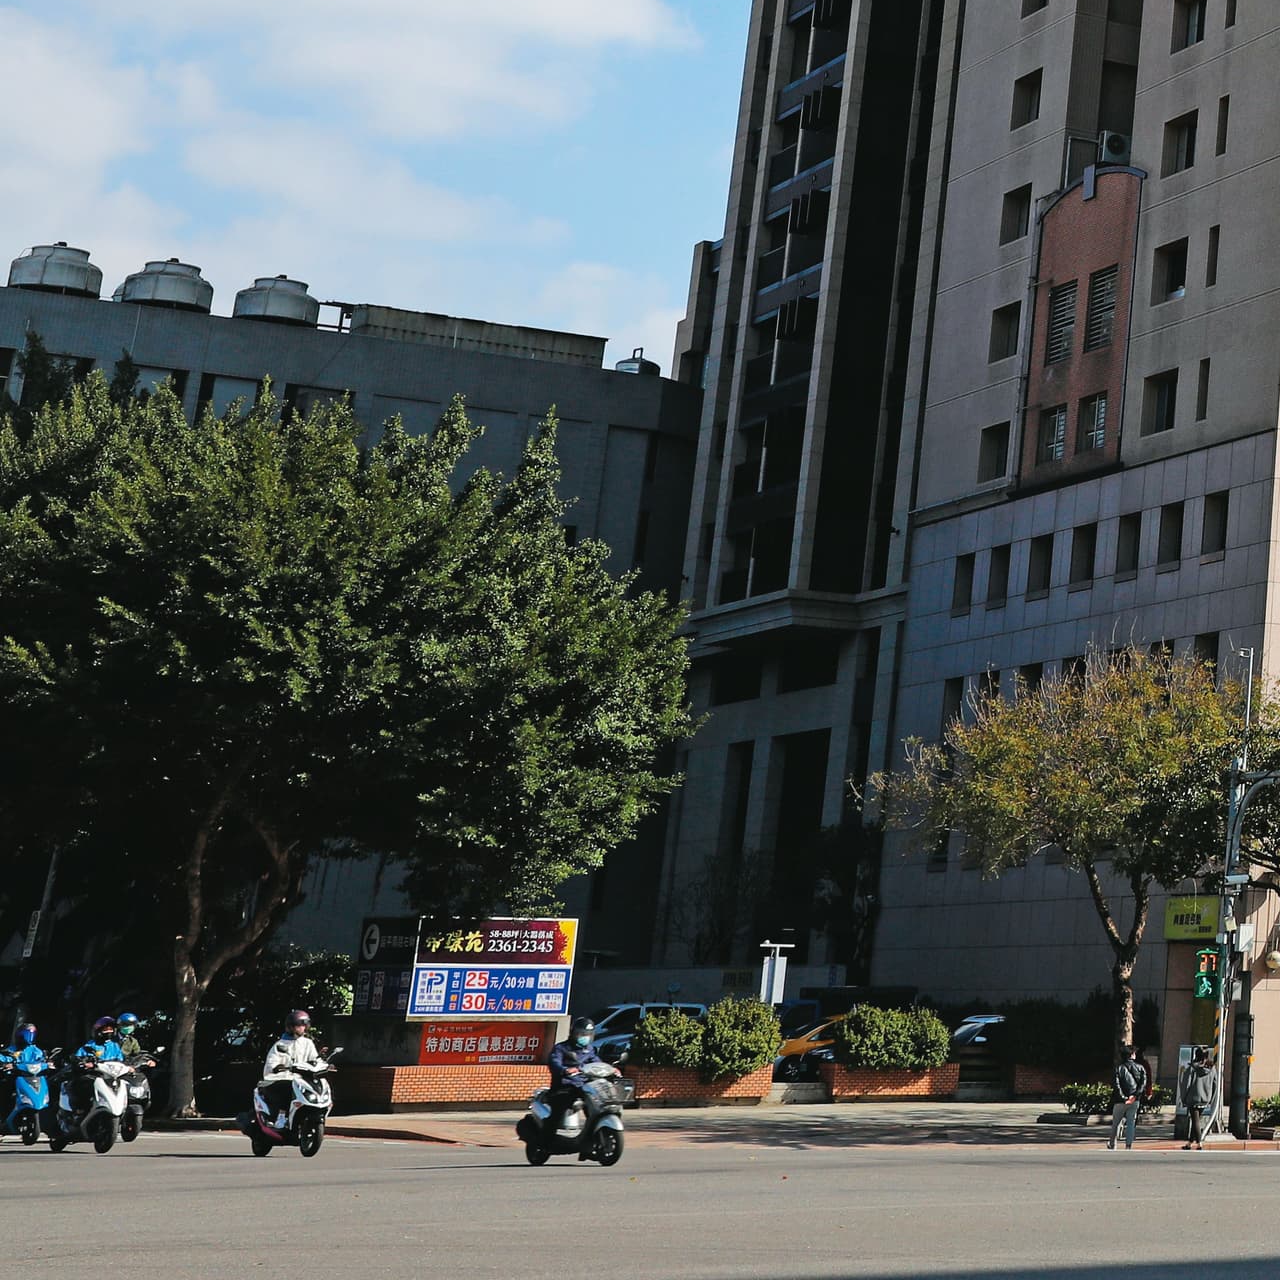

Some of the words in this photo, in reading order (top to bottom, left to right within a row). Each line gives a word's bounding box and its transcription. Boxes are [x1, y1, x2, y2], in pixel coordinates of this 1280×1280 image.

[488, 939, 554, 953] 2361-2345
[1199, 954, 1217, 972] 27
[425, 1036, 540, 1053] 特約商店優惠招募中
